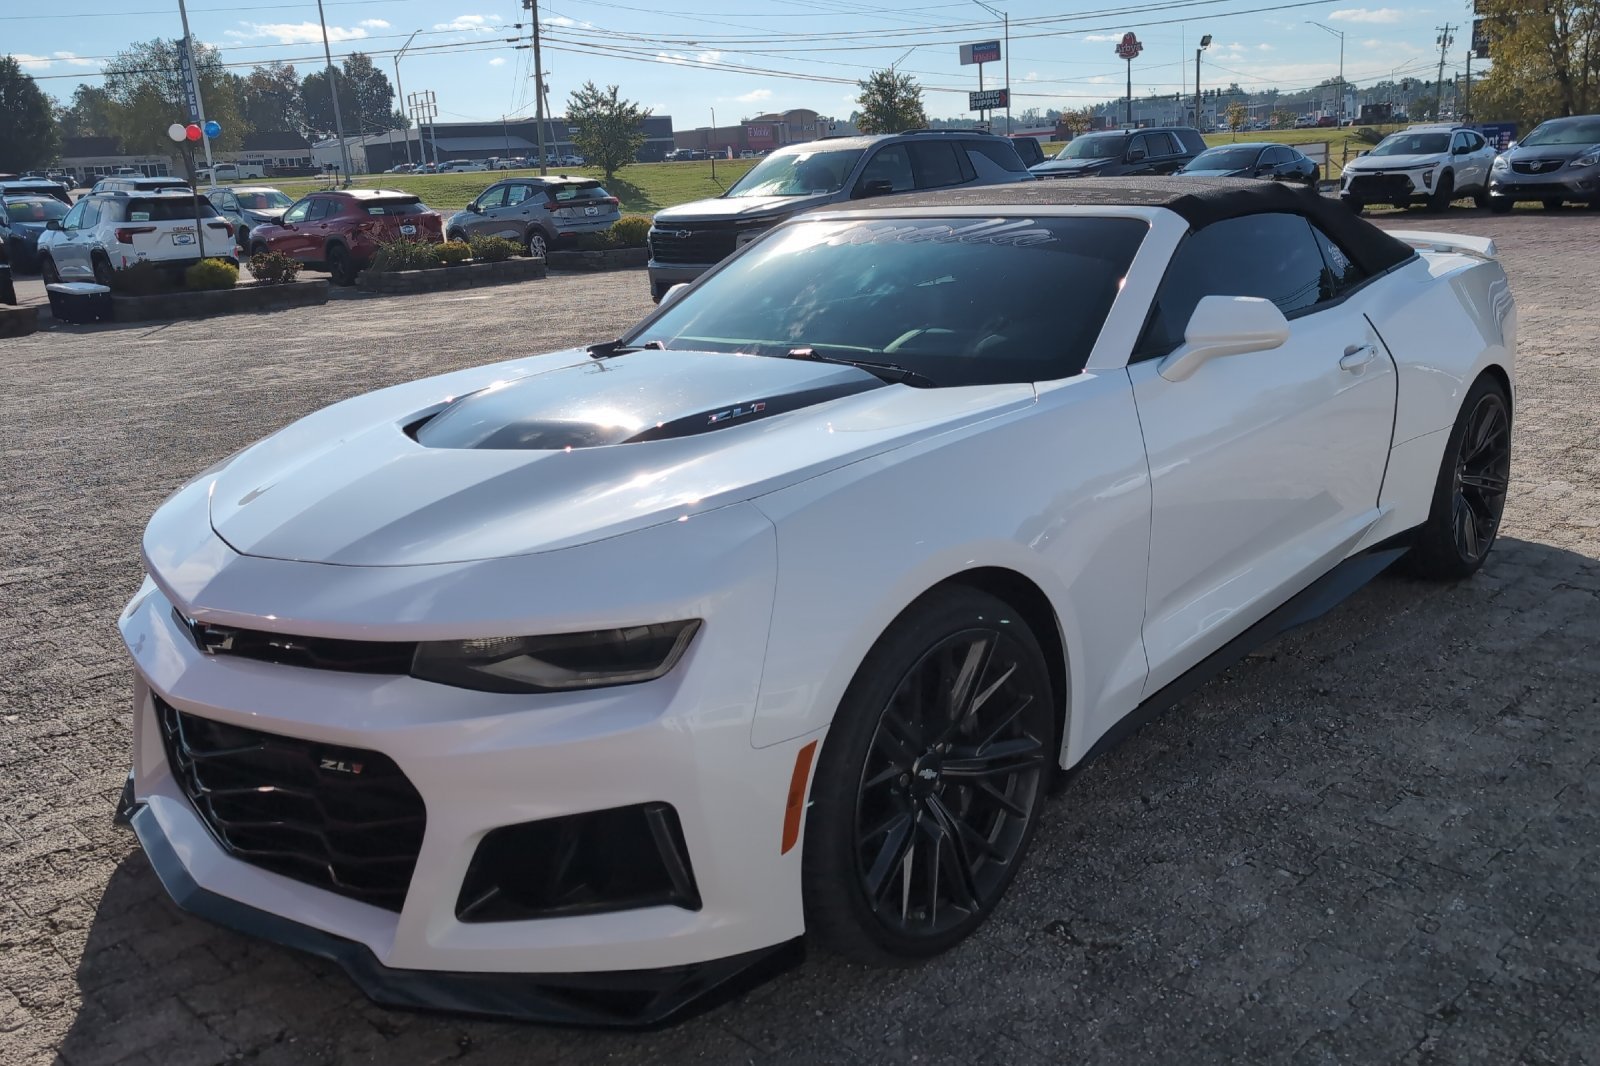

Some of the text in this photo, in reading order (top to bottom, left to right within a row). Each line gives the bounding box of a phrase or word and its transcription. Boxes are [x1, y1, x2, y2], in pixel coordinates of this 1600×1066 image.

[181, 58, 197, 116] OWNED
[970, 90, 1000, 101] SIDING
[970, 97, 1000, 108] SUPPLY
[707, 402, 766, 425] ZL1
